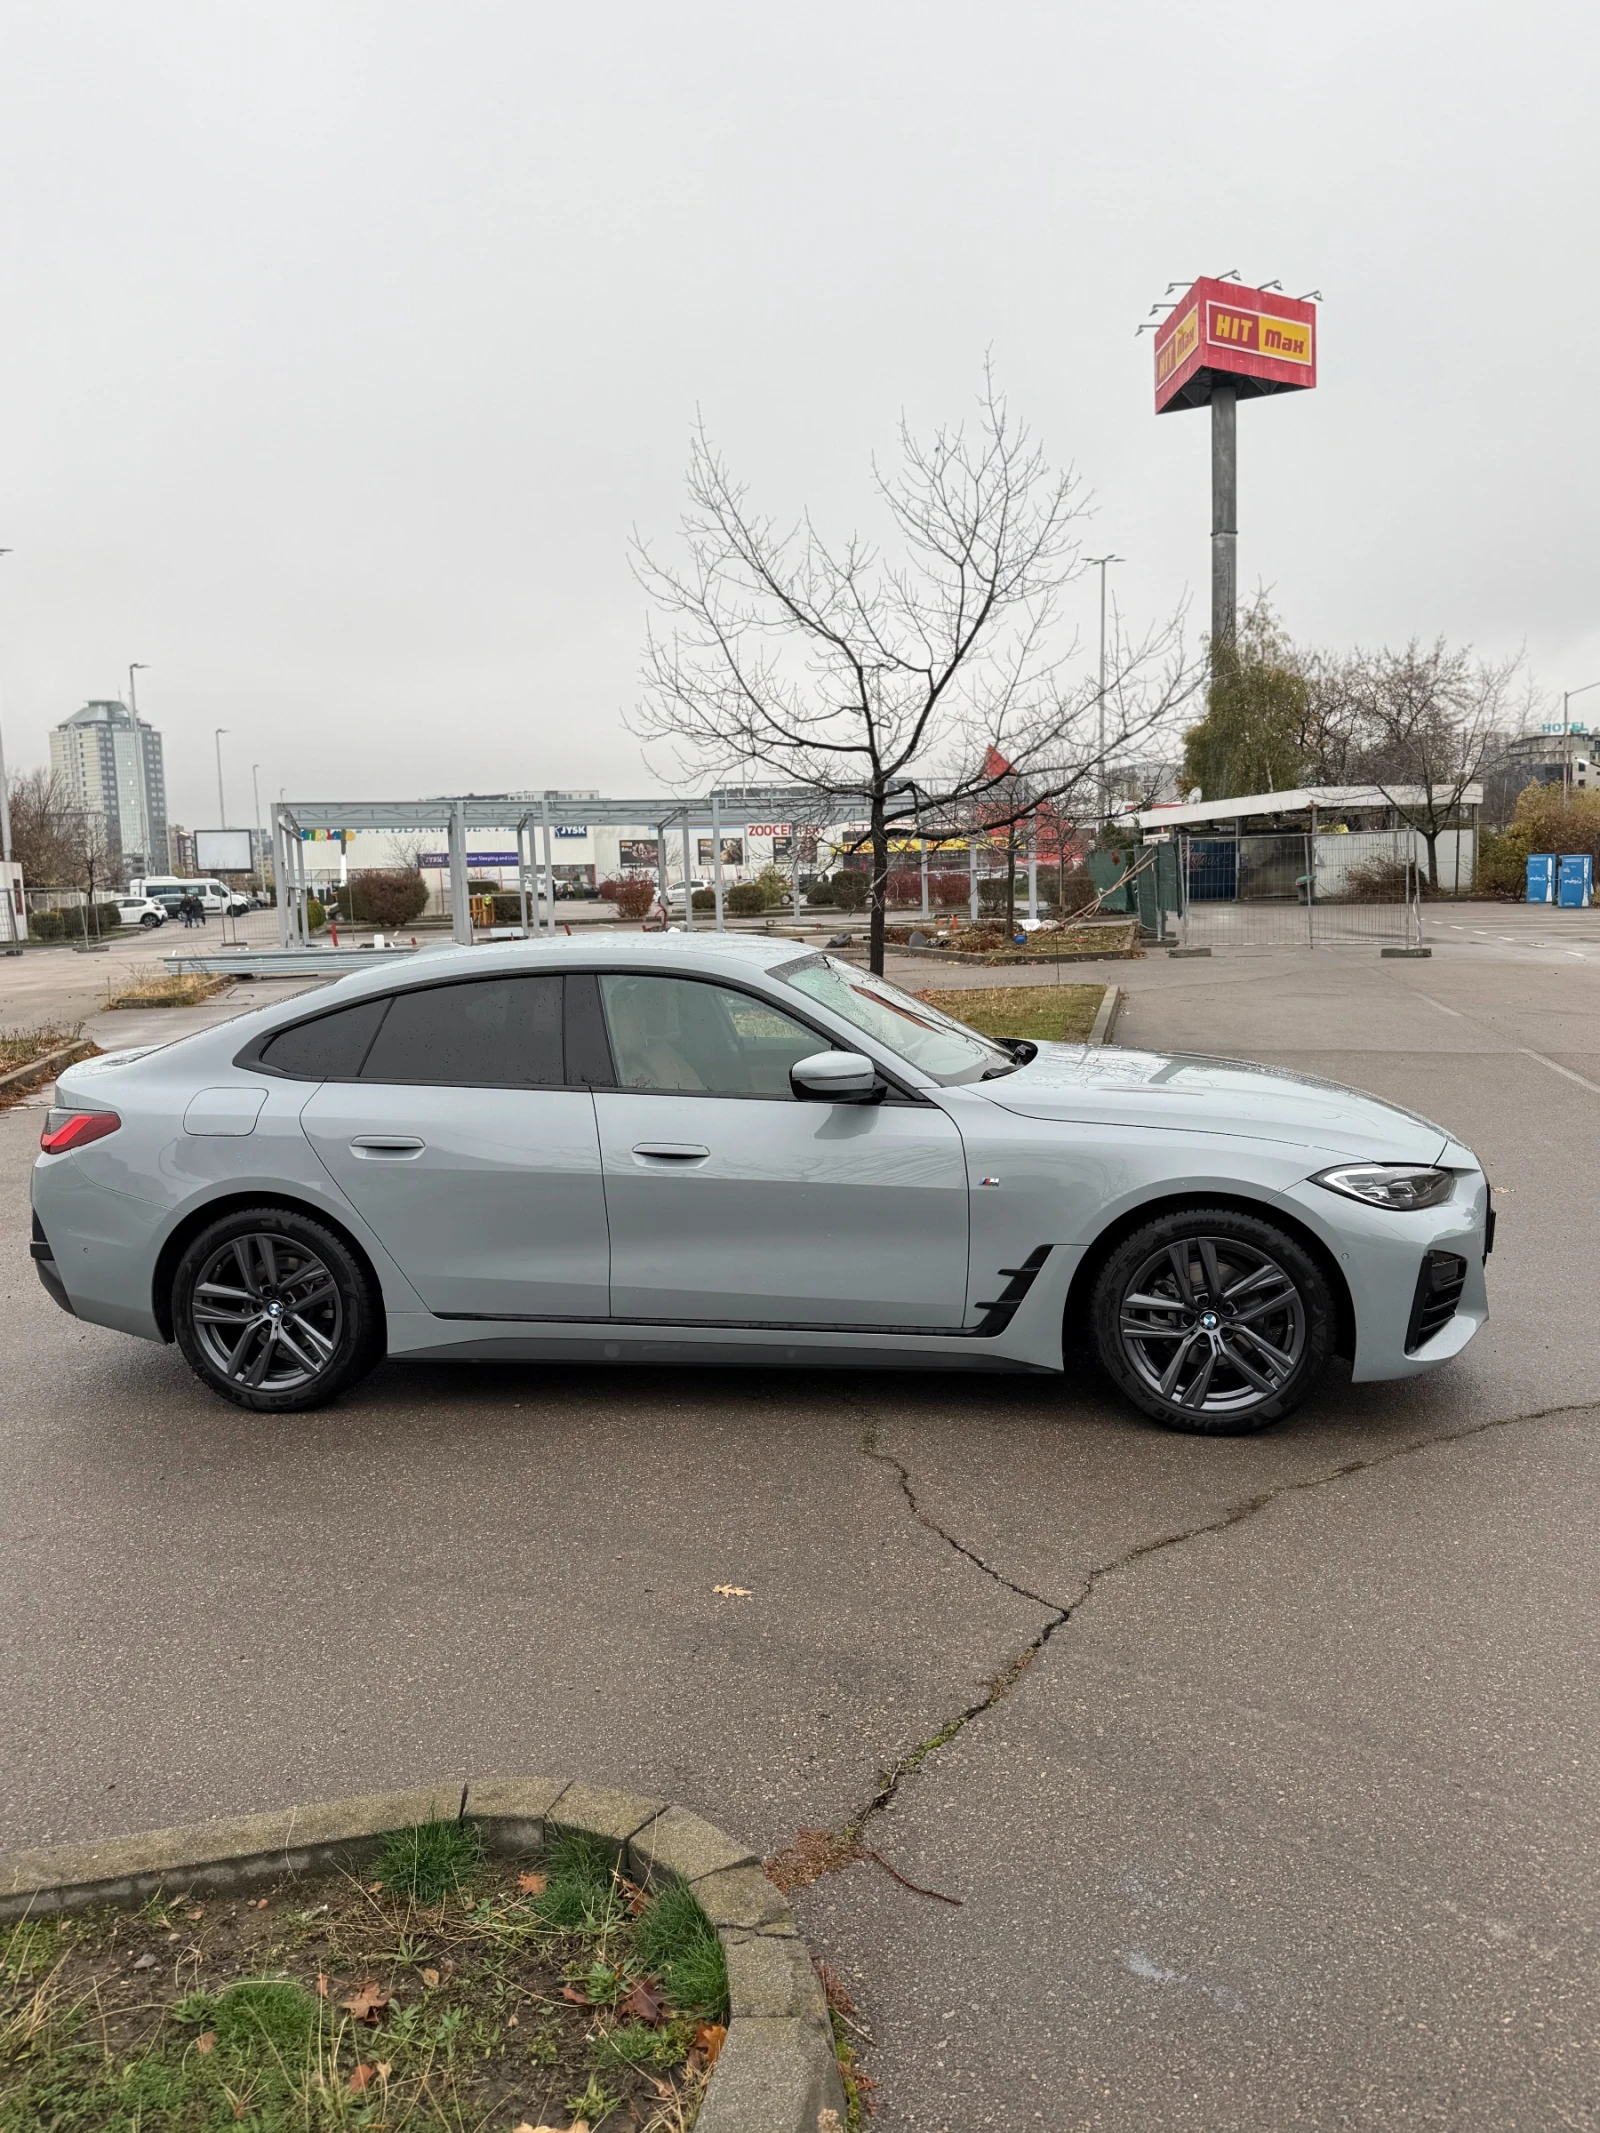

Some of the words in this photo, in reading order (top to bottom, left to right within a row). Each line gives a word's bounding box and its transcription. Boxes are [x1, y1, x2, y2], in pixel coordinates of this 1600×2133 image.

[1216, 314, 1252, 342] HIT
[1264, 329, 1304, 354] Max
[1159, 343, 1174, 379] HIT
[560, 825, 586, 835] JYSK
[748, 824, 822, 837] ZOOCETER
